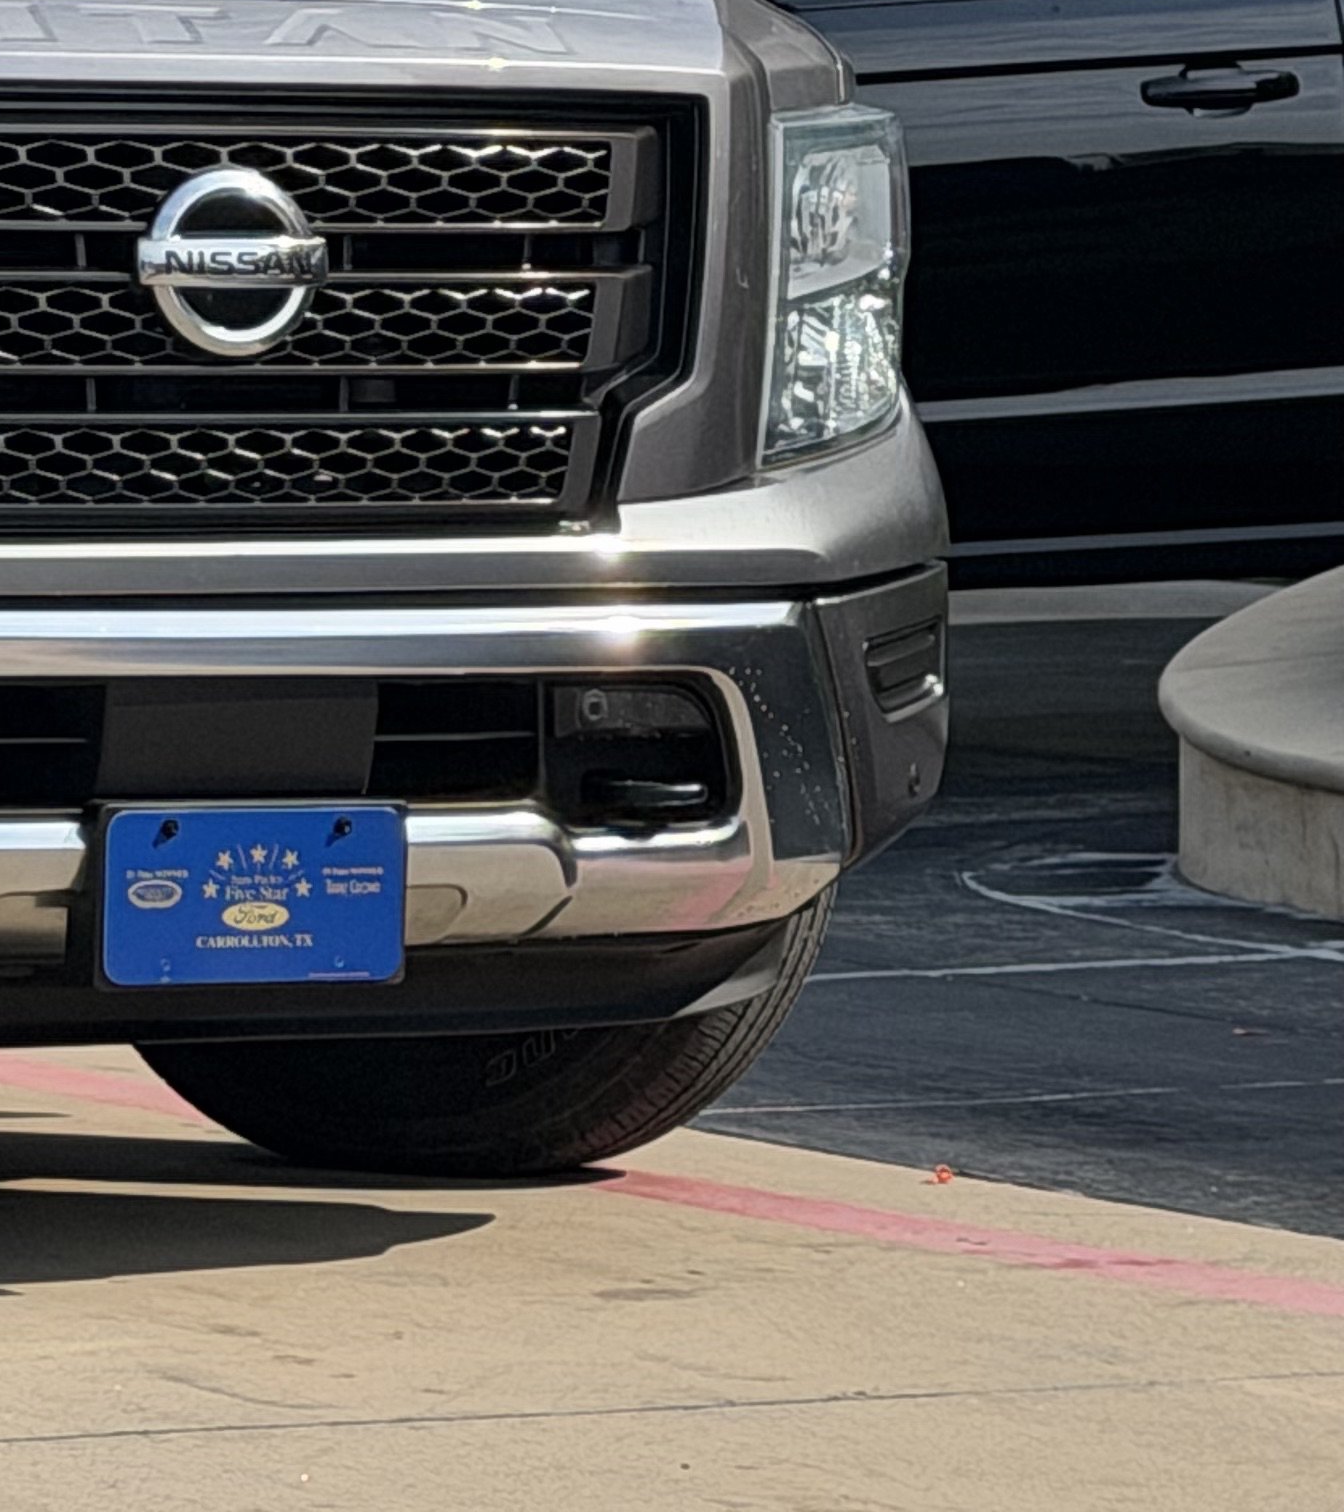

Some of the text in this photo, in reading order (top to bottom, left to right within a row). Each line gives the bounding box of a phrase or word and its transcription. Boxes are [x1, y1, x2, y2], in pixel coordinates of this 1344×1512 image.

[164, 249, 314, 276] NISSAN
[225, 886, 289, 901] Five Star
[233, 906, 279, 925] Ford
[294, 934, 313, 947] TX
